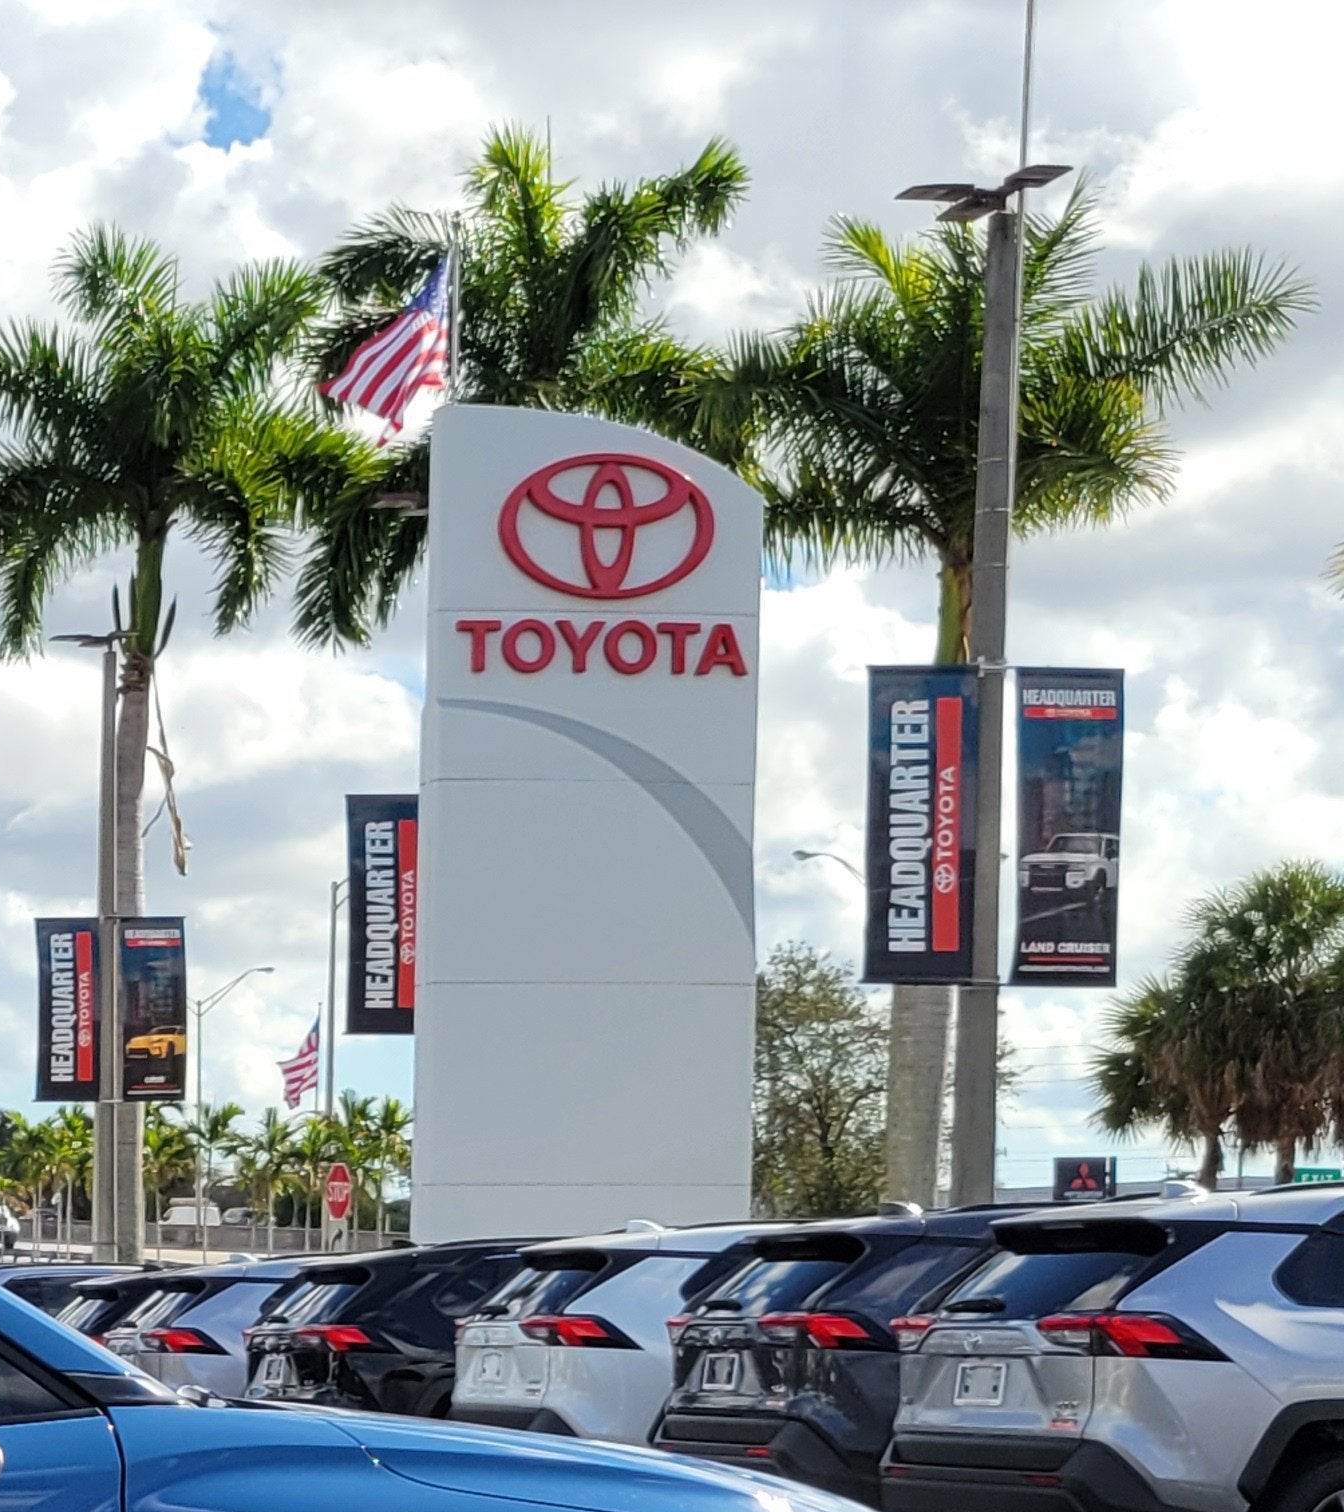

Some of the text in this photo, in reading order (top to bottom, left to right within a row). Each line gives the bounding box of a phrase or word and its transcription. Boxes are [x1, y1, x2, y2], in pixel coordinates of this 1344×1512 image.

[455, 619, 748, 677] TOYOTA
[1023, 689, 1116, 706] HEADQUARTER
[888, 699, 933, 952] HEADQUARTER
[937, 766, 956, 860] TOYOTA
[365, 821, 399, 1009] HEADQUARTER
[401, 870, 414, 941] TOYOTA
[1020, 941, 1055, 953] LAND
[50, 933, 77, 1082] HEADQUARTER
[79, 972, 89, 1026] TOYOTA
[327, 1181, 350, 1202] STOP
